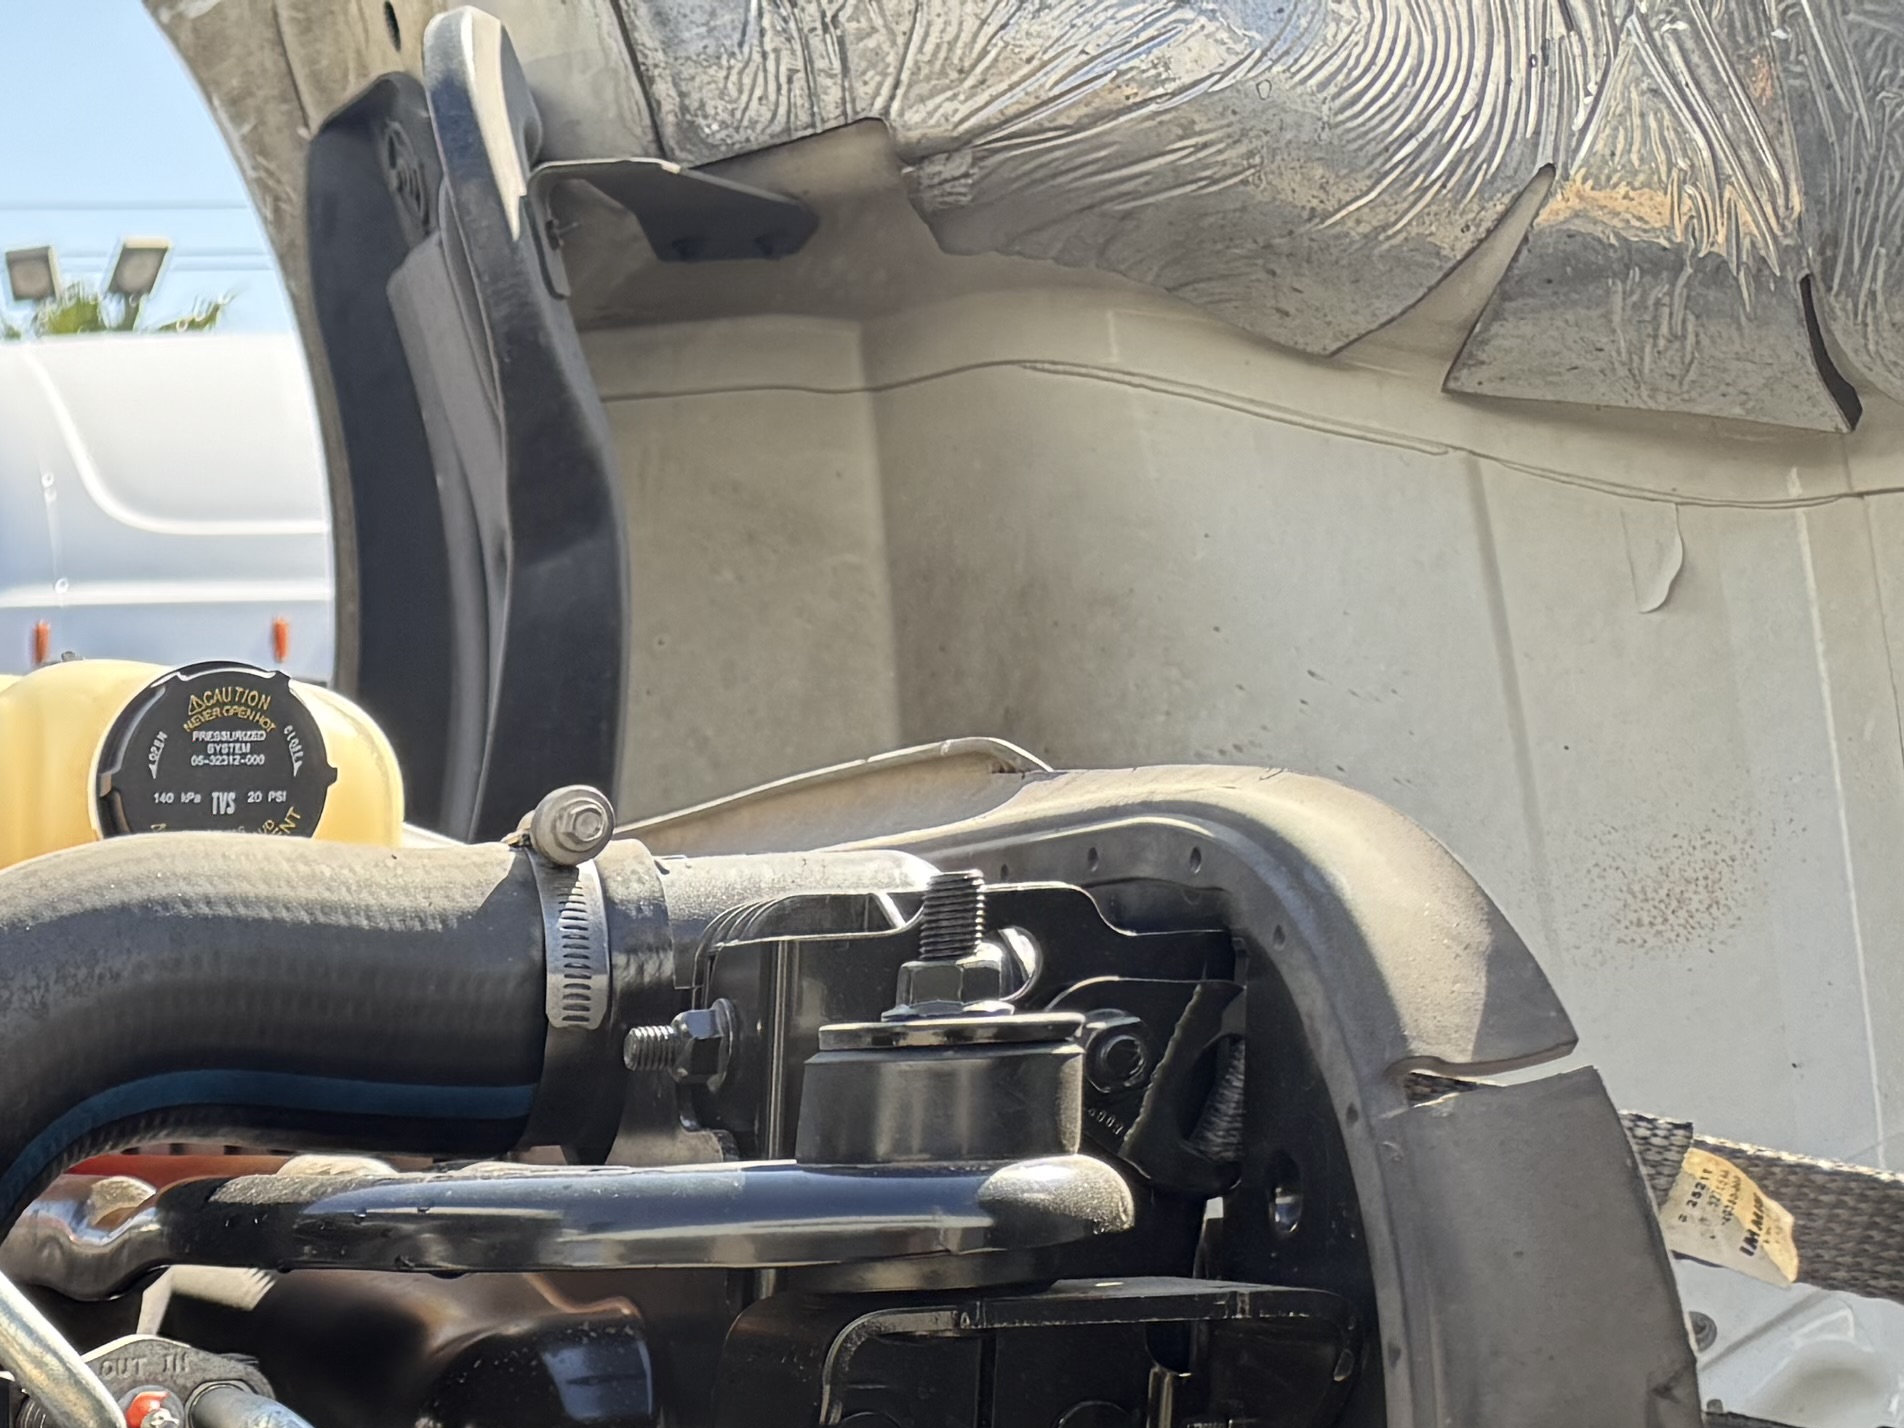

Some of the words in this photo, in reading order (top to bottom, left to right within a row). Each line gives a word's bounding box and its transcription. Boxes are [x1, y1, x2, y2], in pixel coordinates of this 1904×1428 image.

[203, 686, 272, 710] CAUTION
[184, 708, 219, 733] NEVER
[254, 712, 277, 734] HOT
[207, 743, 251, 754] SYSTEM
[153, 792, 174, 804] 140
[211, 791, 236, 815] TVS
[247, 792, 263, 804] 20
[268, 792, 287, 804] PSI
[100, 1357, 147, 1379] OUT
